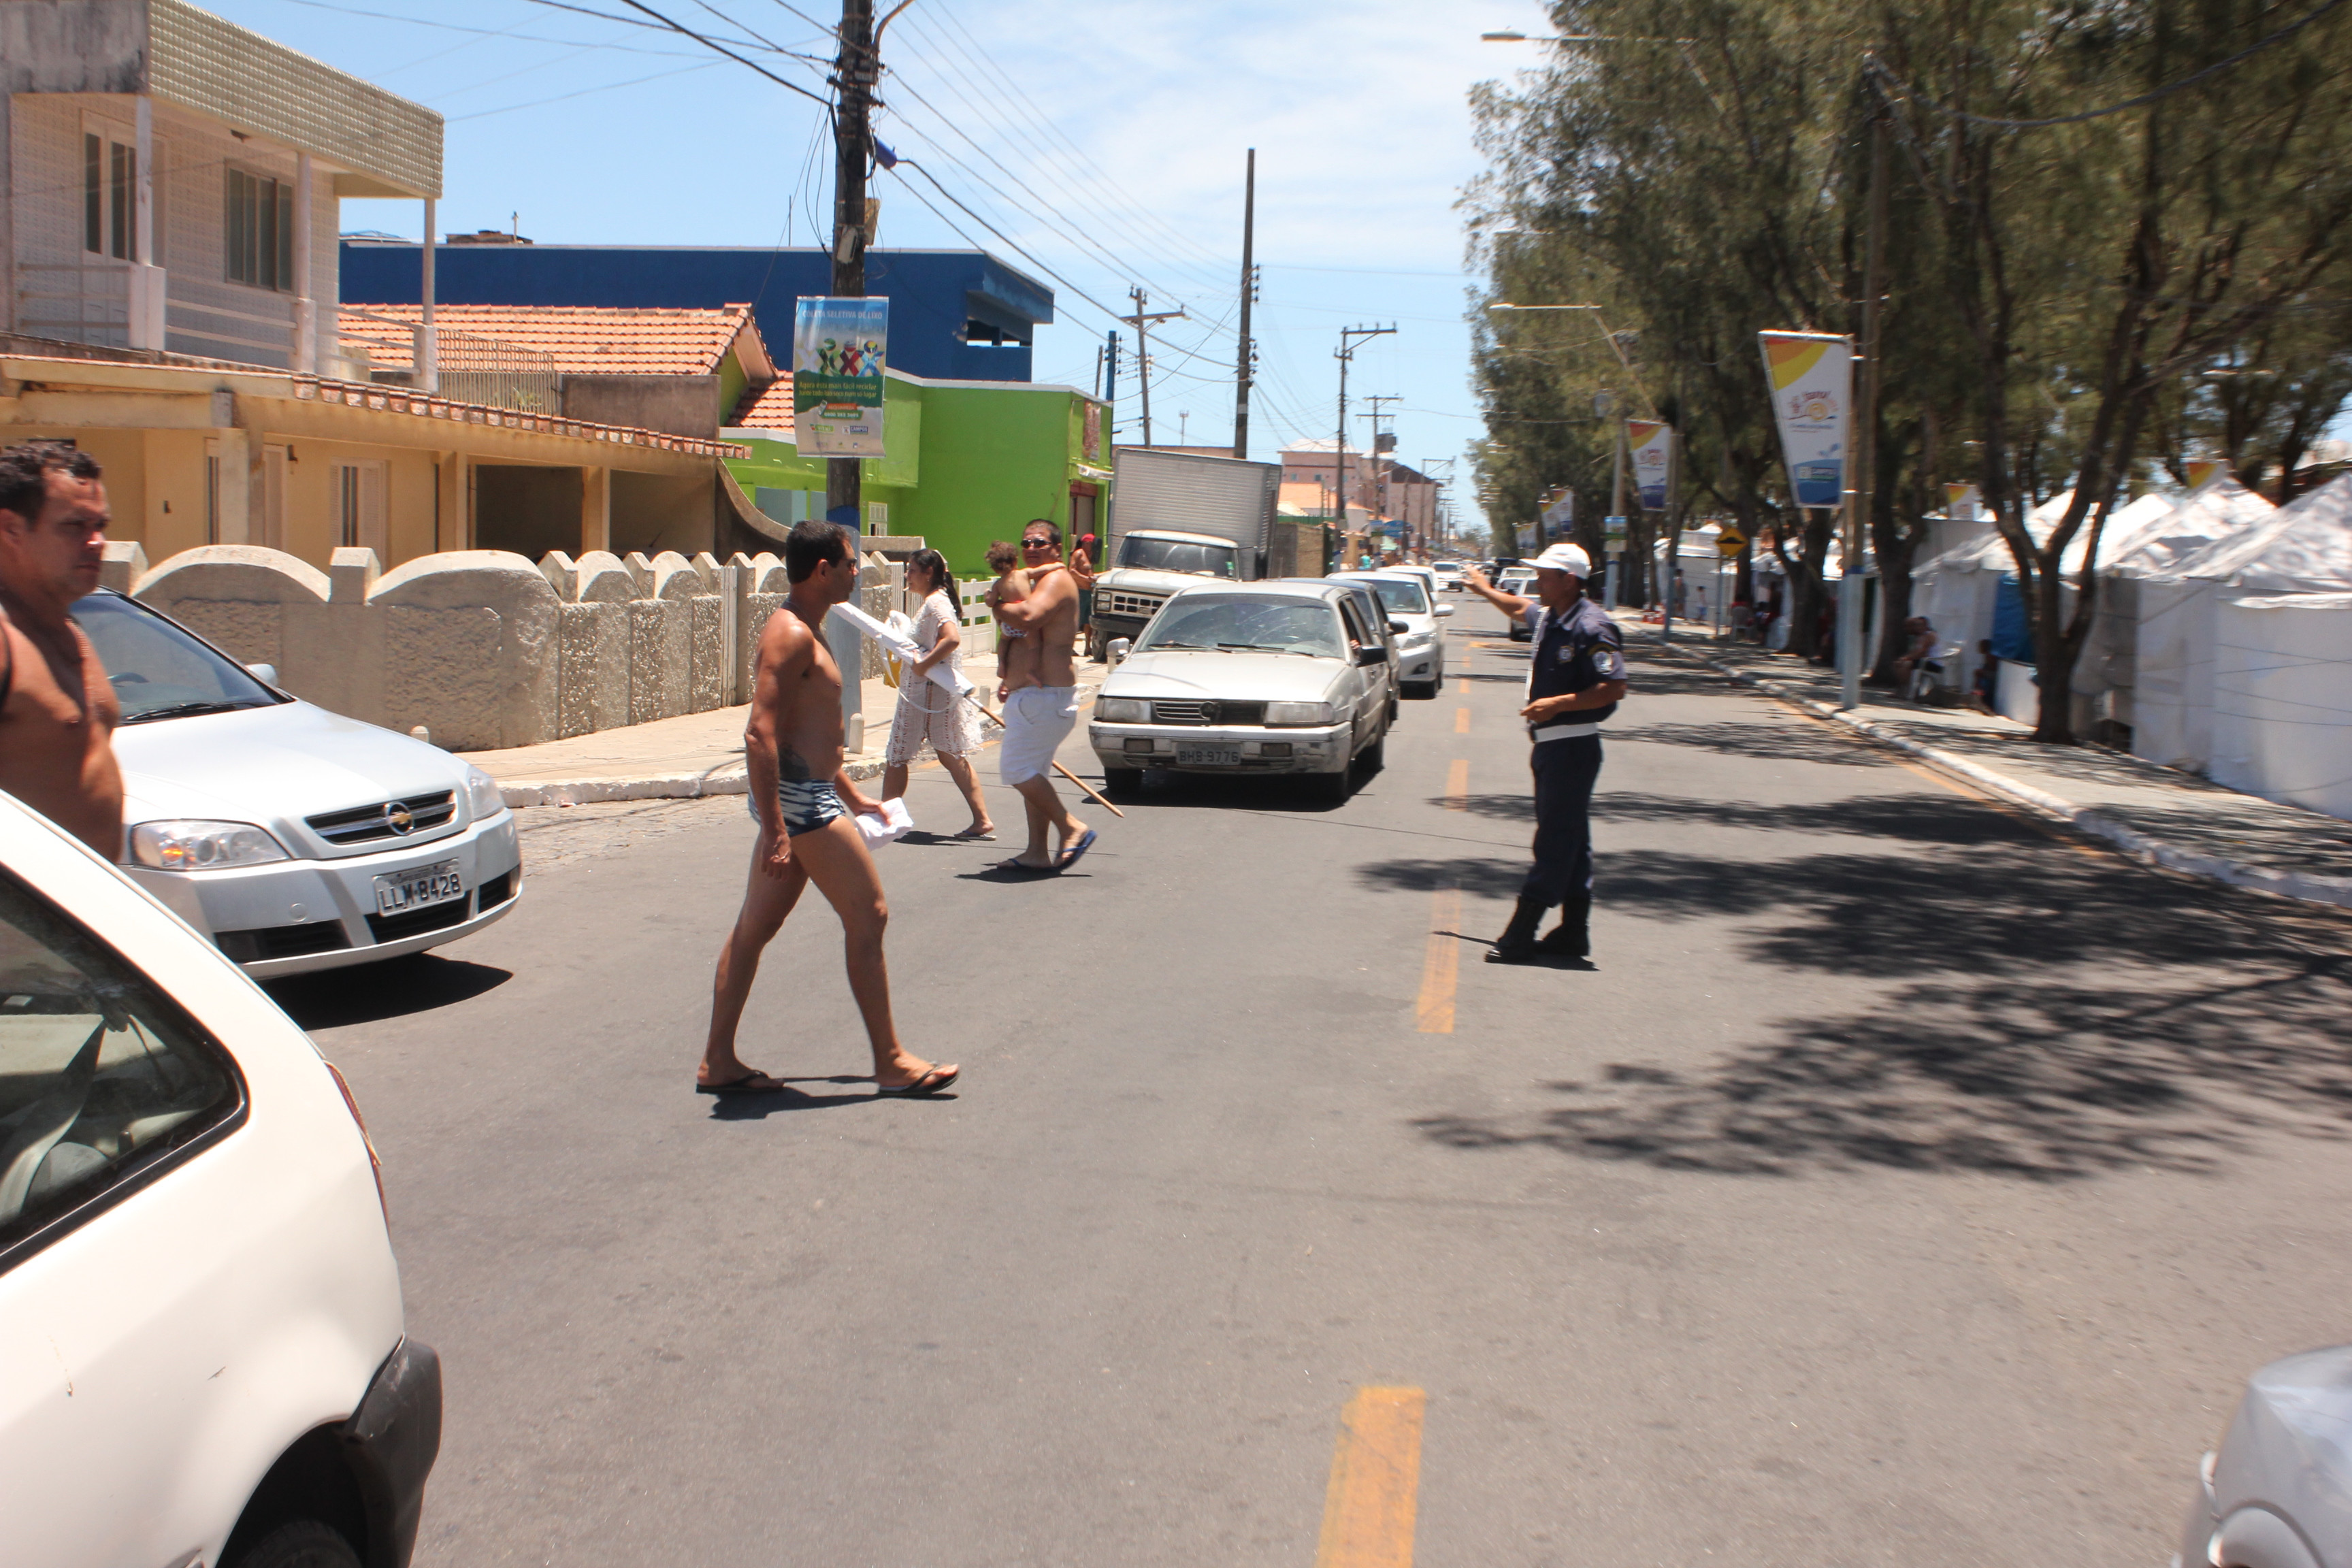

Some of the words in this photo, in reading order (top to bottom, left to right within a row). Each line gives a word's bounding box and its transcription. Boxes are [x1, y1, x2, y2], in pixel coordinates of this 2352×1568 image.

[802, 310, 826, 318] COLETA
[827, 310, 857, 318] SELETIVA
[868, 311, 883, 319] LIXO
[799, 382, 815, 390] Agora
